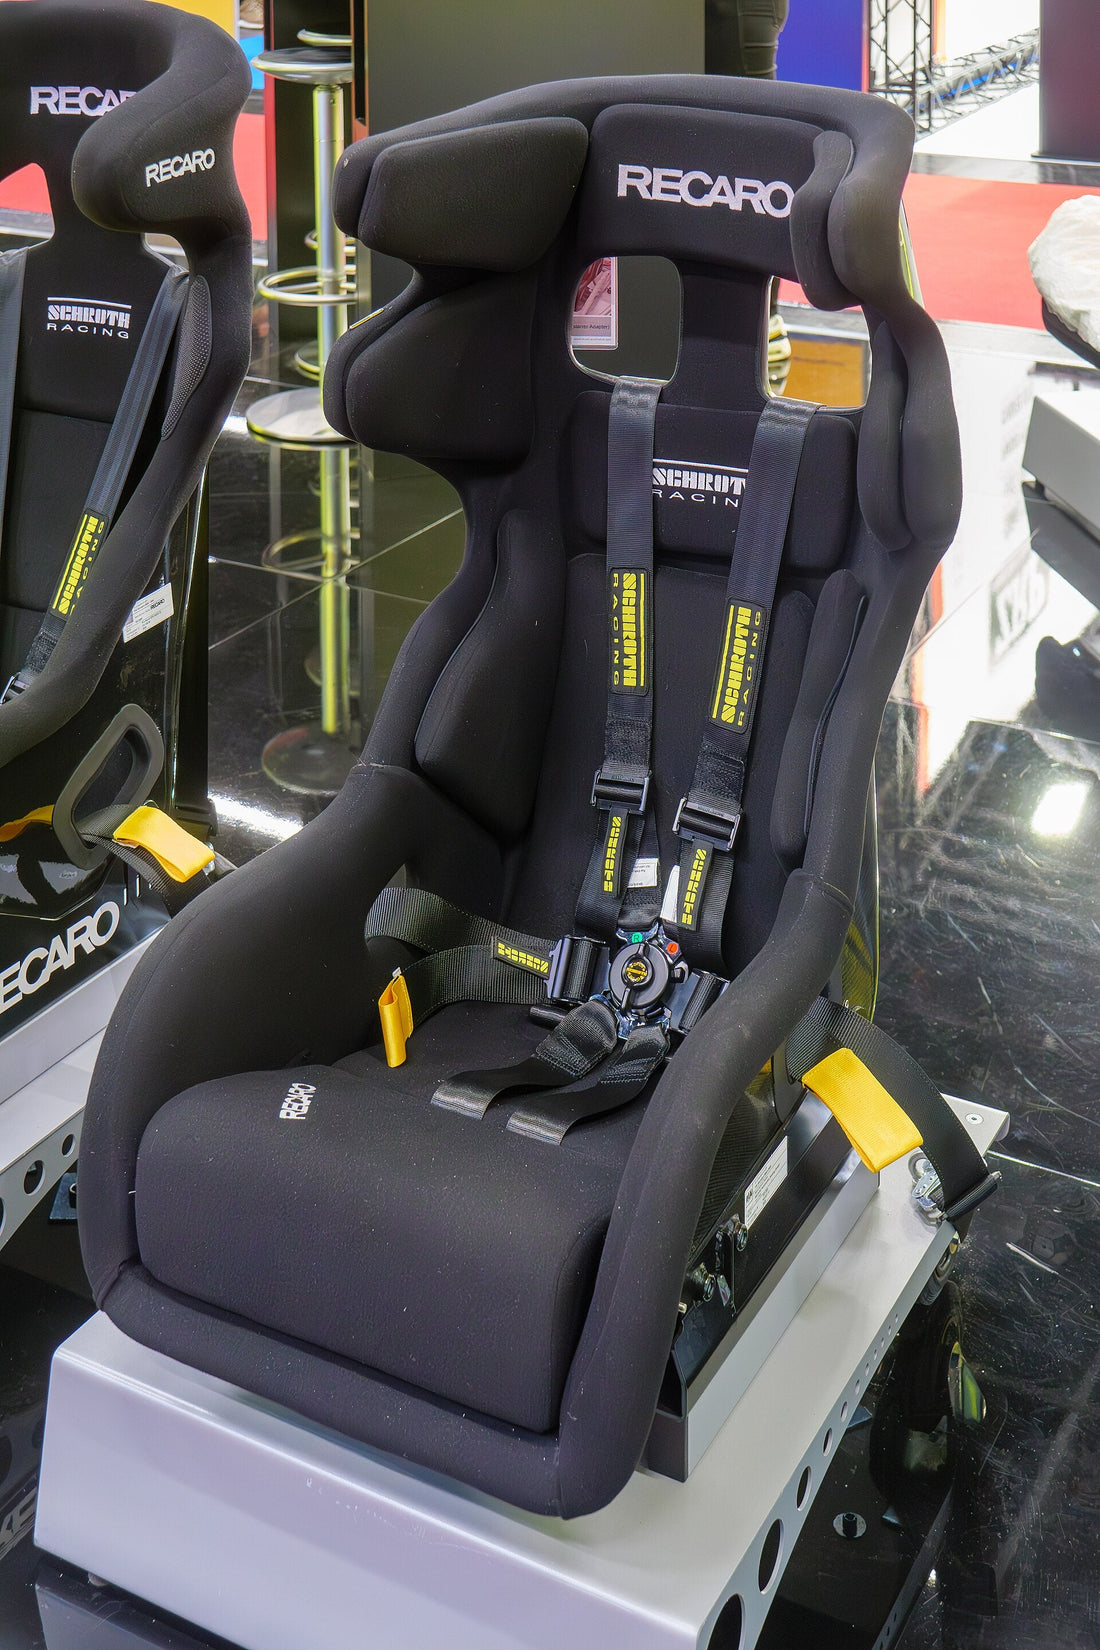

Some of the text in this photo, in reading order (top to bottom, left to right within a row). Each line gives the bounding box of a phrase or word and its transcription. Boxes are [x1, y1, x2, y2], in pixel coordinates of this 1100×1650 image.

[30, 86, 136, 116] RECA
[145, 148, 216, 187] RECARO
[617, 163, 795, 218] RECARO
[46, 322, 129, 339] RACING
[47, 305, 131, 329] SCHROTH
[652, 467, 746, 496] SCHROT
[652, 489, 739, 508] RACIN
[58, 516, 99, 615] SCHROTH
[612, 573, 620, 686] RACING
[622, 573, 638, 687] SCHROTH
[721, 606, 752, 724] SCHROTH
[737, 611, 761, 726] RACING
[603, 816, 622, 892] SCHROTH
[681, 848, 707, 925] SCHROTH
[0, 901, 120, 1014] ECARO
[497, 942, 549, 974] SCHROTH
[279, 1082, 317, 1120] RECARO
